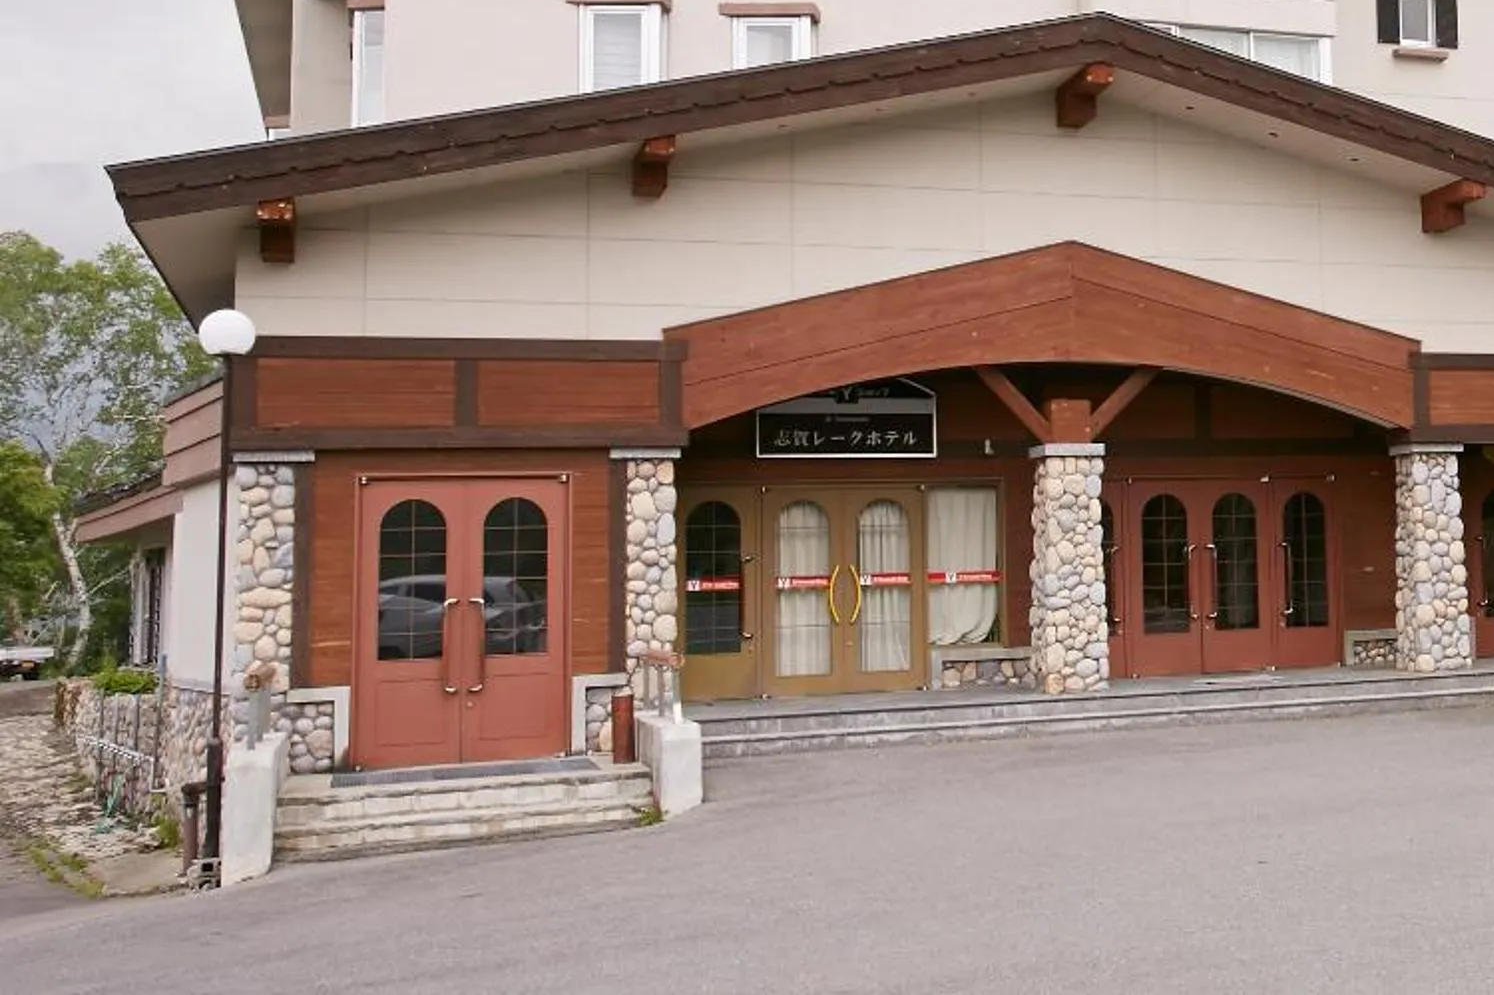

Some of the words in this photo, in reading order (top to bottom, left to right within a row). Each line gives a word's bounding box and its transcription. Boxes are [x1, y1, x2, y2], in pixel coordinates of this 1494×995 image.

[774, 430, 918, 446] 志賀レークホテル
